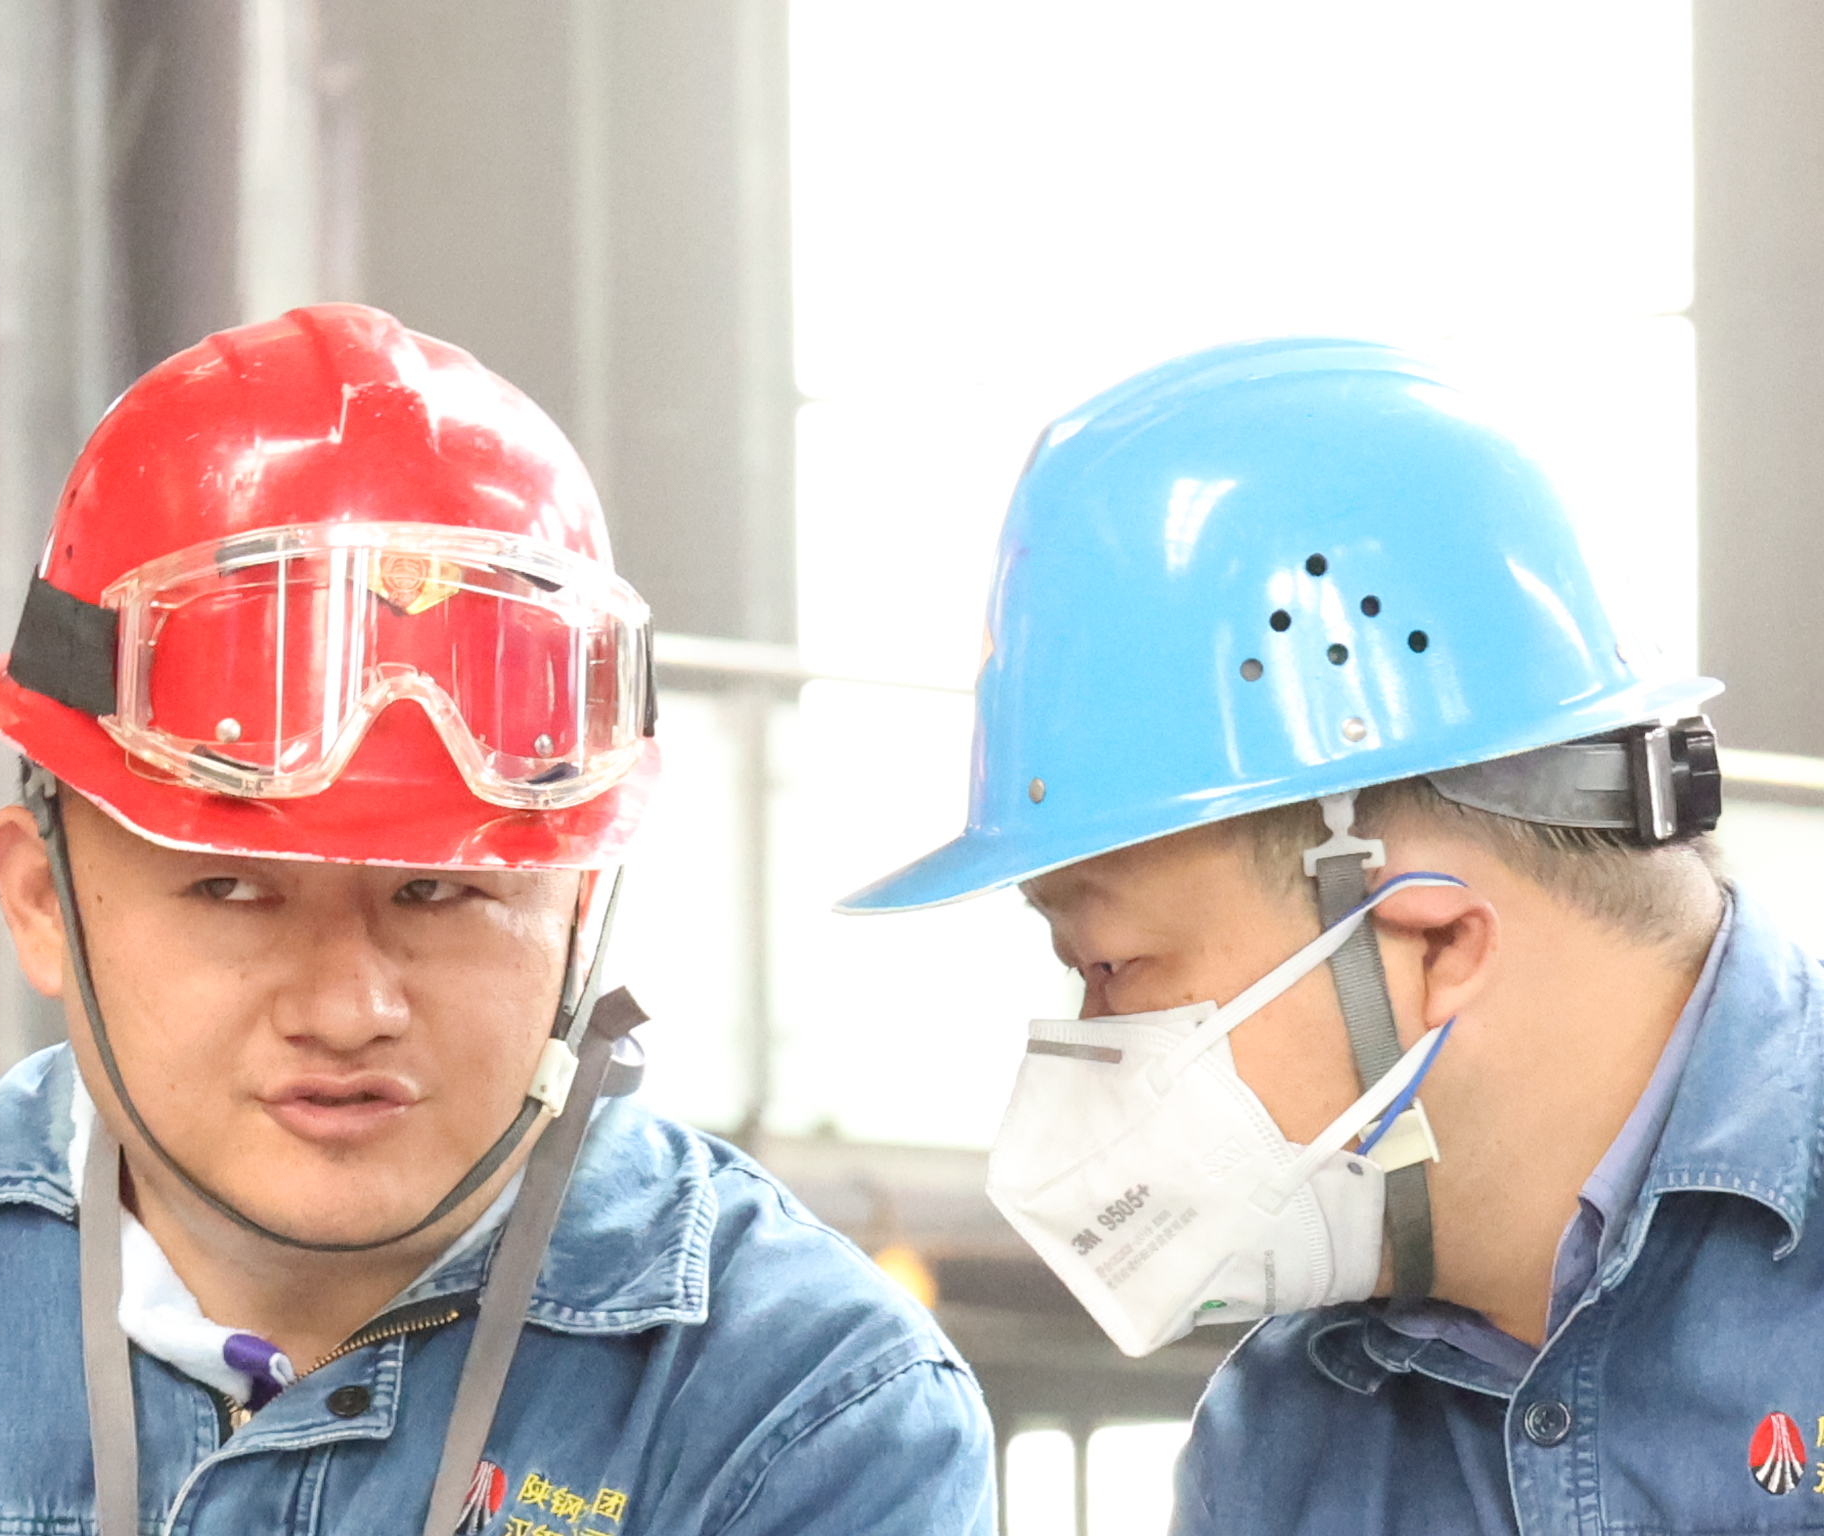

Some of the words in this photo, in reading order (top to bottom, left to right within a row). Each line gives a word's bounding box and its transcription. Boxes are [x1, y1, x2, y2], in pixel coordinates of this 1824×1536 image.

[1071, 1227, 1103, 1257] 3M
[1097, 1183, 1151, 1232] 9505+
[517, 1472, 629, 1523] 陕钢团
